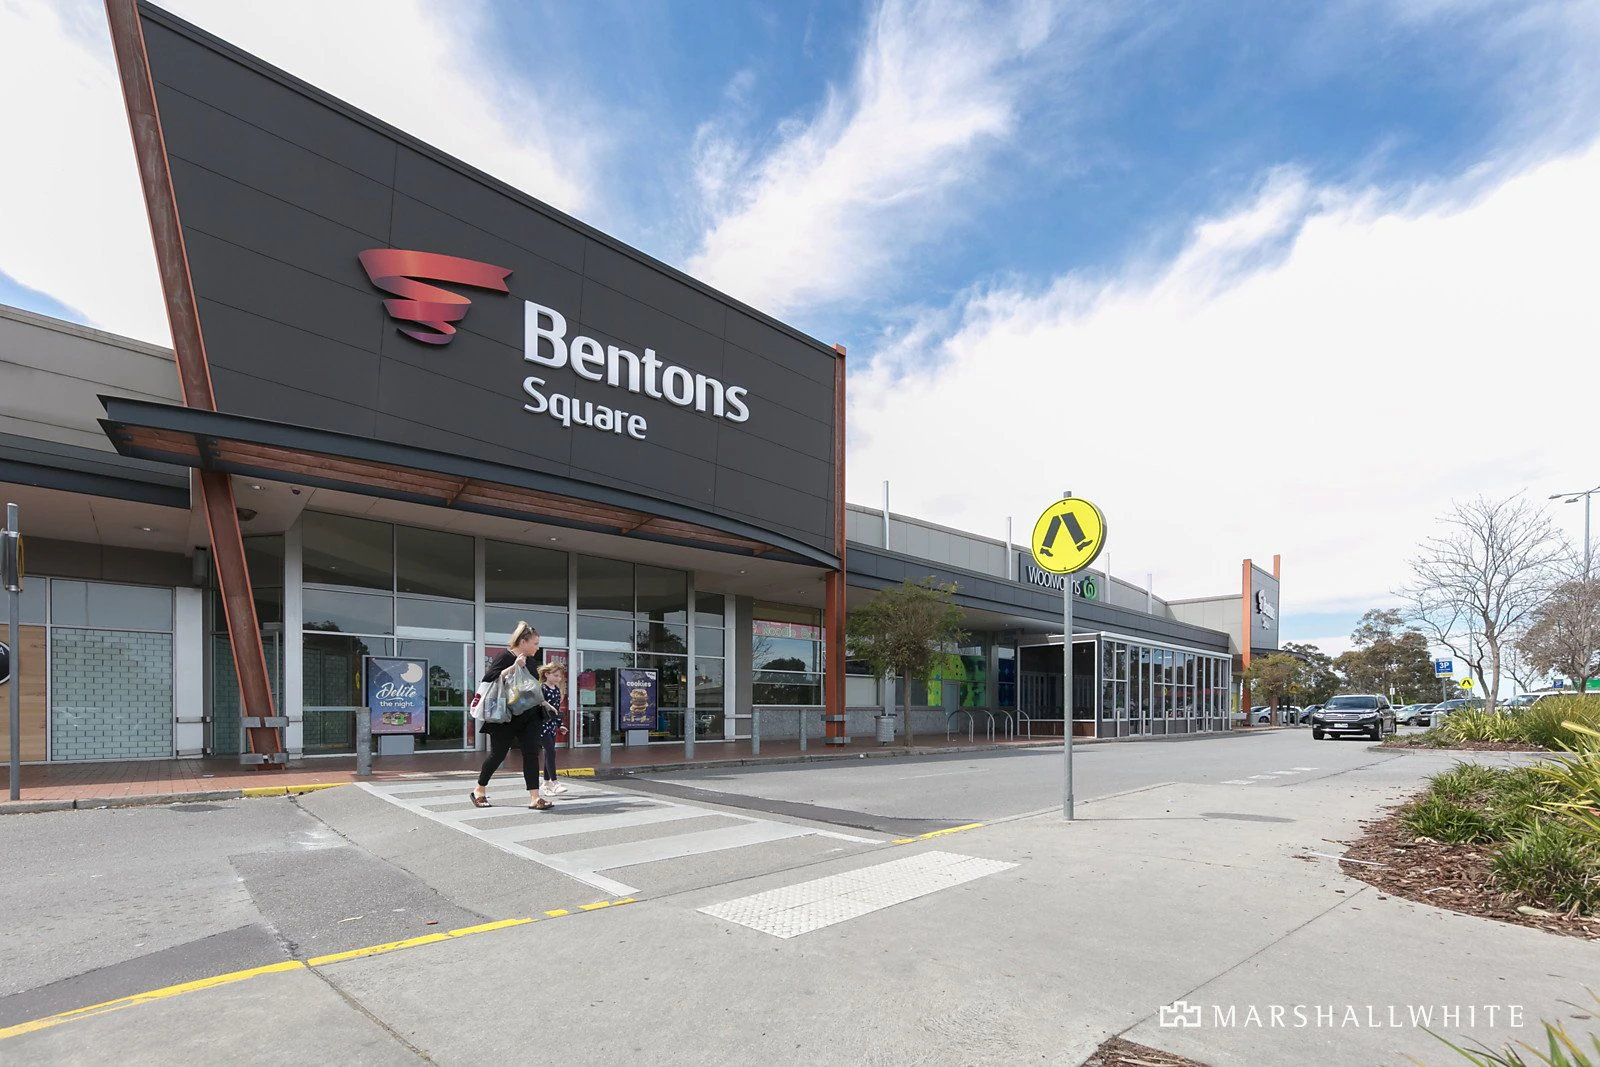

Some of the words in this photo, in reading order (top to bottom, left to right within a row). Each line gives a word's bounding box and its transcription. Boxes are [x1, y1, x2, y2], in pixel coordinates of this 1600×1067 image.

[524, 300, 750, 424] Bentons
[523, 376, 647, 440] Square
[375, 682, 417, 699] Delite
